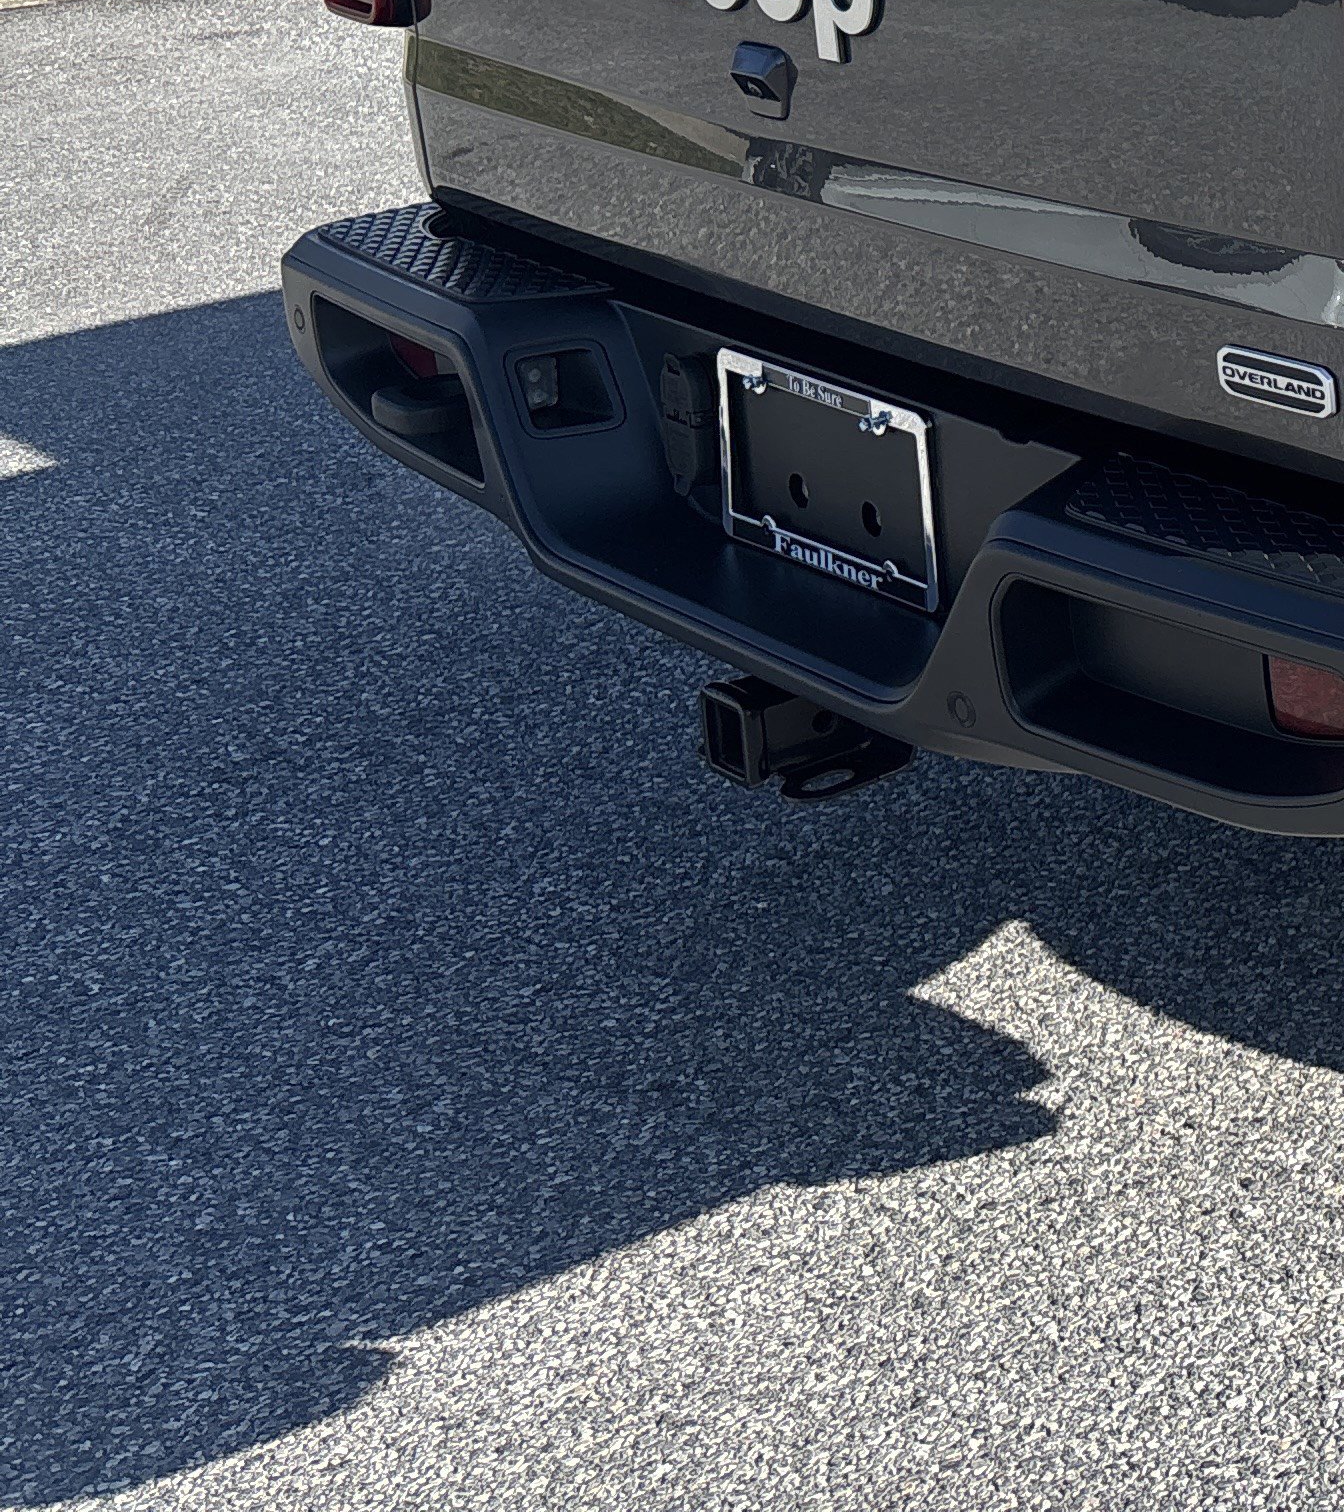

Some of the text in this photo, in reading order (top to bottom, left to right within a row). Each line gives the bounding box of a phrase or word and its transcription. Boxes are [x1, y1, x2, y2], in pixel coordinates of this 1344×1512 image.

[786, 373, 842, 408] To Be Sure
[1221, 365, 1326, 401] OVERLAND
[772, 532, 883, 592] Faulkner
